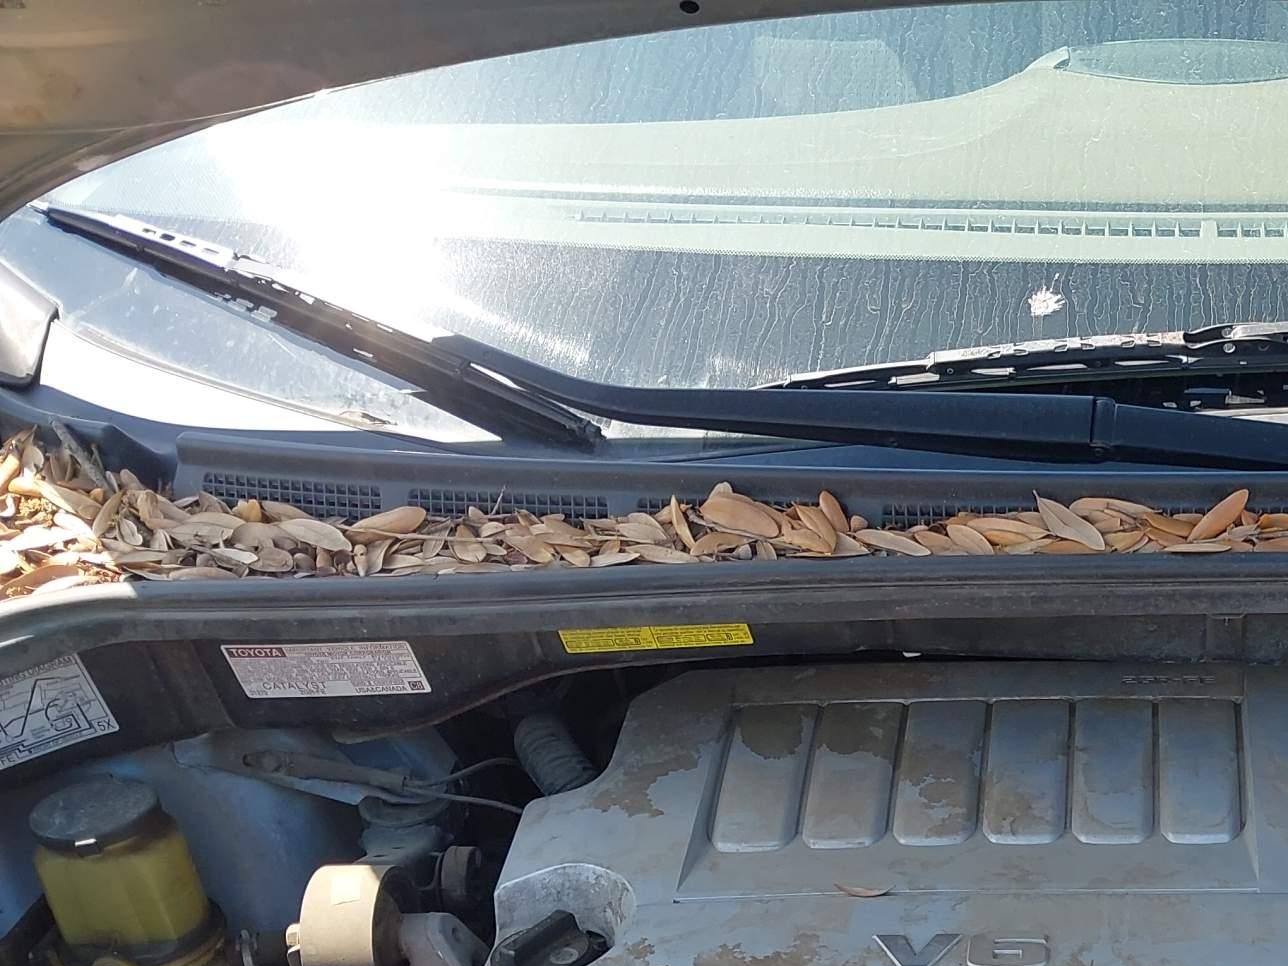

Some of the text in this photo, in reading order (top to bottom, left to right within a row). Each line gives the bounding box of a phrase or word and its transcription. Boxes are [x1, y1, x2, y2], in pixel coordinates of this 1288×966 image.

[231, 649, 282, 657] TOYOTA
[262, 681, 327, 690] CATALYST
[97, 719, 114, 732] 5X
